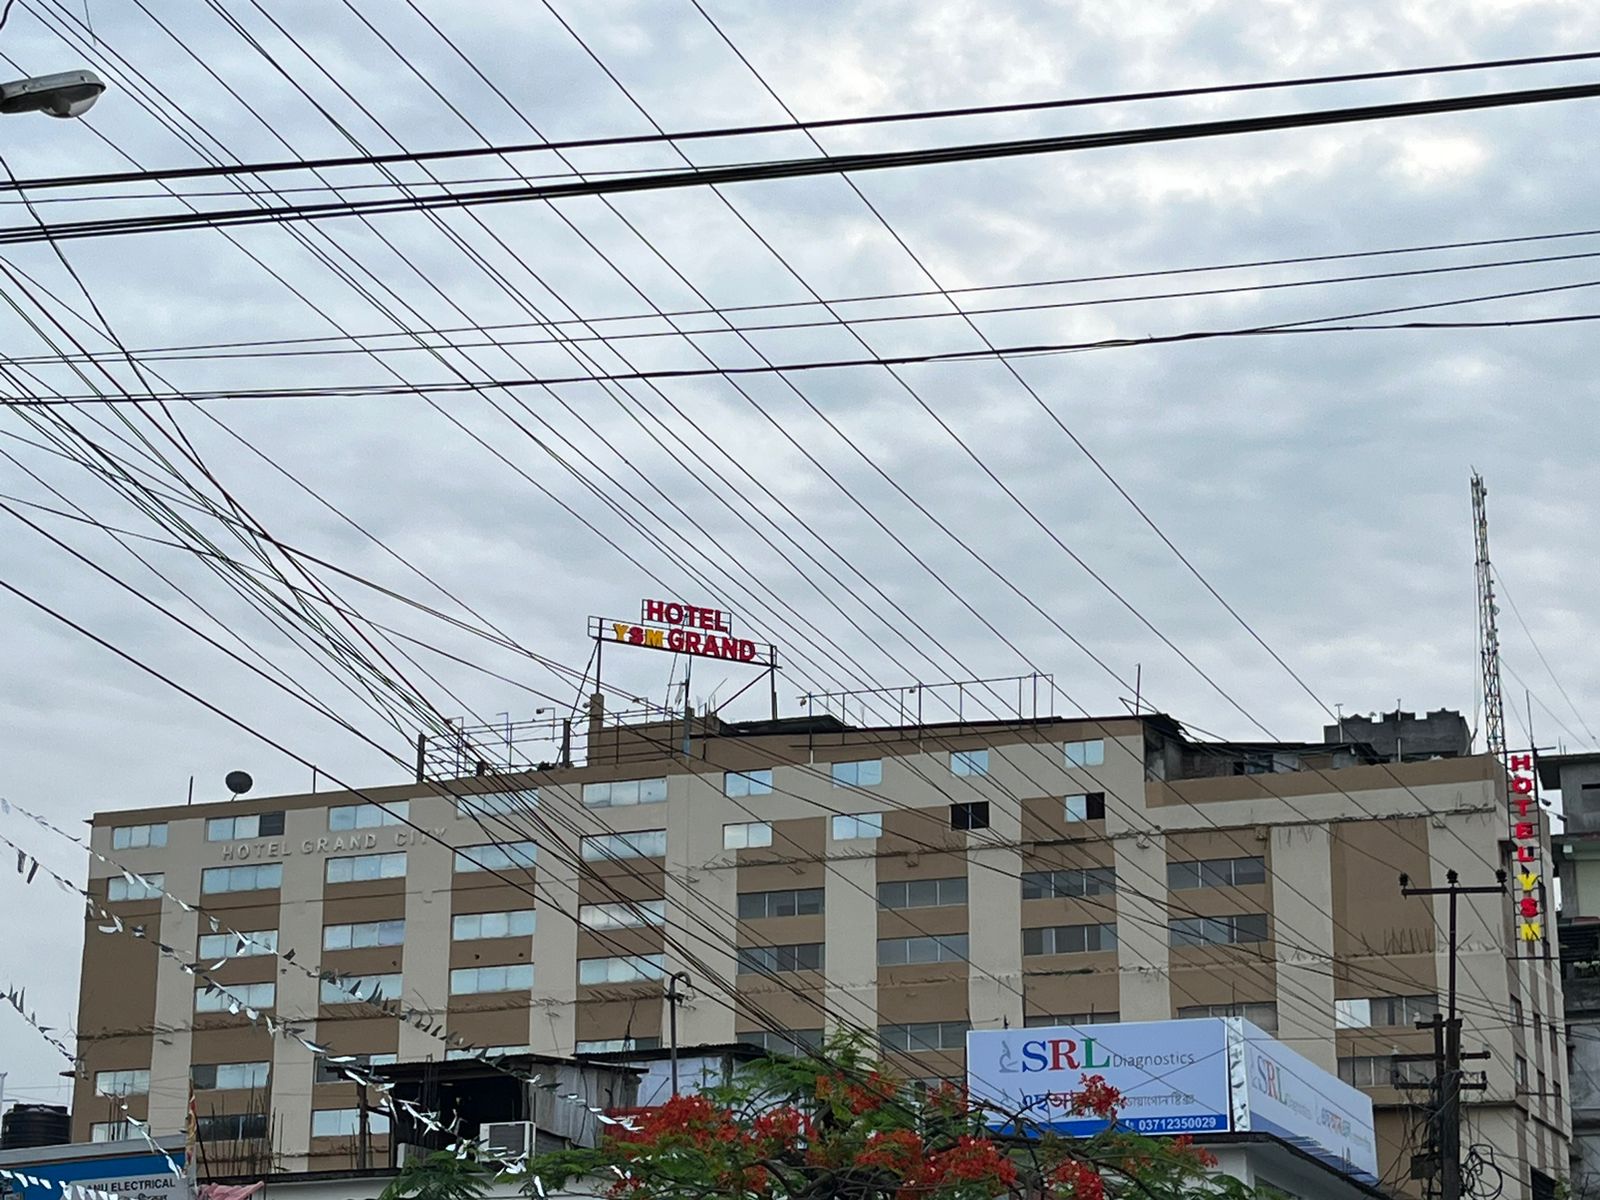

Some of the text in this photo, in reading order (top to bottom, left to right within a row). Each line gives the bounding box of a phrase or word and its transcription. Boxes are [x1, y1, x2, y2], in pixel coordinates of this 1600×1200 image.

[646, 599, 729, 632] HOTEL
[613, 623, 756, 662] YSM GRAND
[222, 827, 449, 861] HOTEL GRAND CITY
[1511, 755, 1541, 941] HOTEL YSM
[1022, 1038, 1195, 1072] SRL Diagnostics
[1257, 1055, 1288, 1105] SRL
[1138, 1117, 1217, 1131] 03712350029
[111, 1178, 176, 1193] ELECTRICAL
